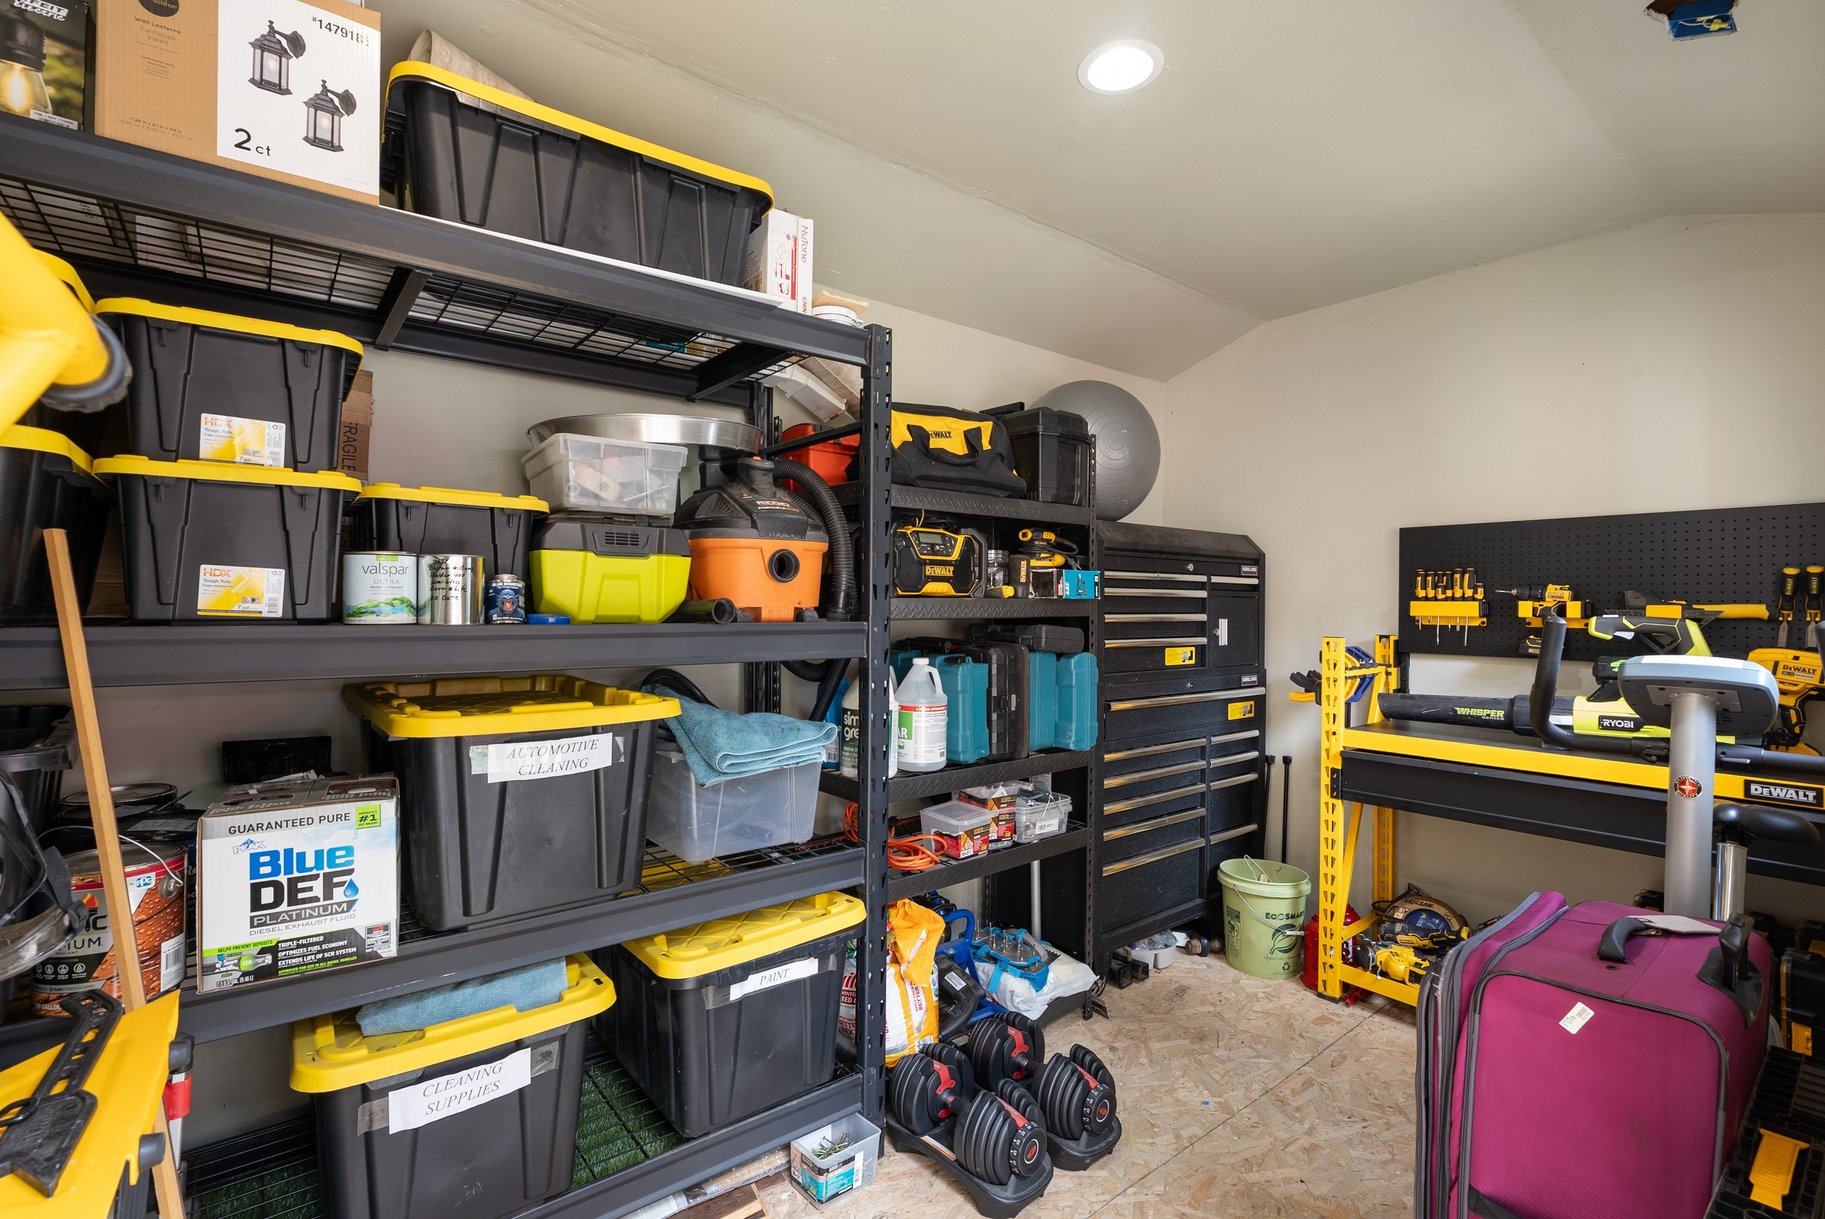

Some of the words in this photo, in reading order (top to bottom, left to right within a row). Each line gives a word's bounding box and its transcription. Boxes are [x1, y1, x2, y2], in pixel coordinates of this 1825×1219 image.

[134, 16, 150, 25] Wall
[151, 22, 181, 34] Lanterns
[234, 128, 252, 152] 2
[255, 145, 271, 156] ct
[800, 225, 809, 263] NuTone
[204, 416, 233, 429] HDX
[341, 421, 358, 472] RAGILE
[203, 567, 232, 578] HDX
[361, 562, 409, 578] valspar
[925, 565, 954, 577] DEWALT
[1782, 664, 1817, 674] DEWALT
[843, 711, 860, 727] sim
[1455, 707, 1505, 718] WHISPER
[1602, 718, 1634, 729] RYOBI
[843, 726, 860, 741] gre
[507, 739, 600, 760] AUTOMOTIVE
[518, 757, 589, 776] CLEANING
[1750, 782, 1817, 804] DEWALT
[228, 816, 314, 835] GUARANTEED
[319, 812, 351, 825] PURE
[358, 814, 378, 823] #1
[232, 839, 267, 855] PEAK
[249, 845, 355, 881] Blue
[136, 875, 153, 888] PPG
[249, 867, 355, 914] DEF
[253, 902, 348, 926] PLATINUM
[249, 926, 285, 936] DIESEL
[285, 918, 328, 930] EXHAUST
[328, 914, 356, 923] FLUID
[232, 943, 252, 951] PREVENT
[278, 935, 324, 948] TRIPLE-FILTERED
[278, 946, 307, 957] OPTIMIZES
[307, 945, 321, 953] FUEL
[321, 940, 348, 950] ECONOMY
[278, 956, 303, 966] EXTENDS
[303, 954, 316, 962] LIFE
[335, 947, 357, 956] SYSTEM
[760, 968, 790, 986] PAINT
[422, 1061, 504, 1098] CLEANING
[425, 1079, 501, 1116] SUPPLIES
